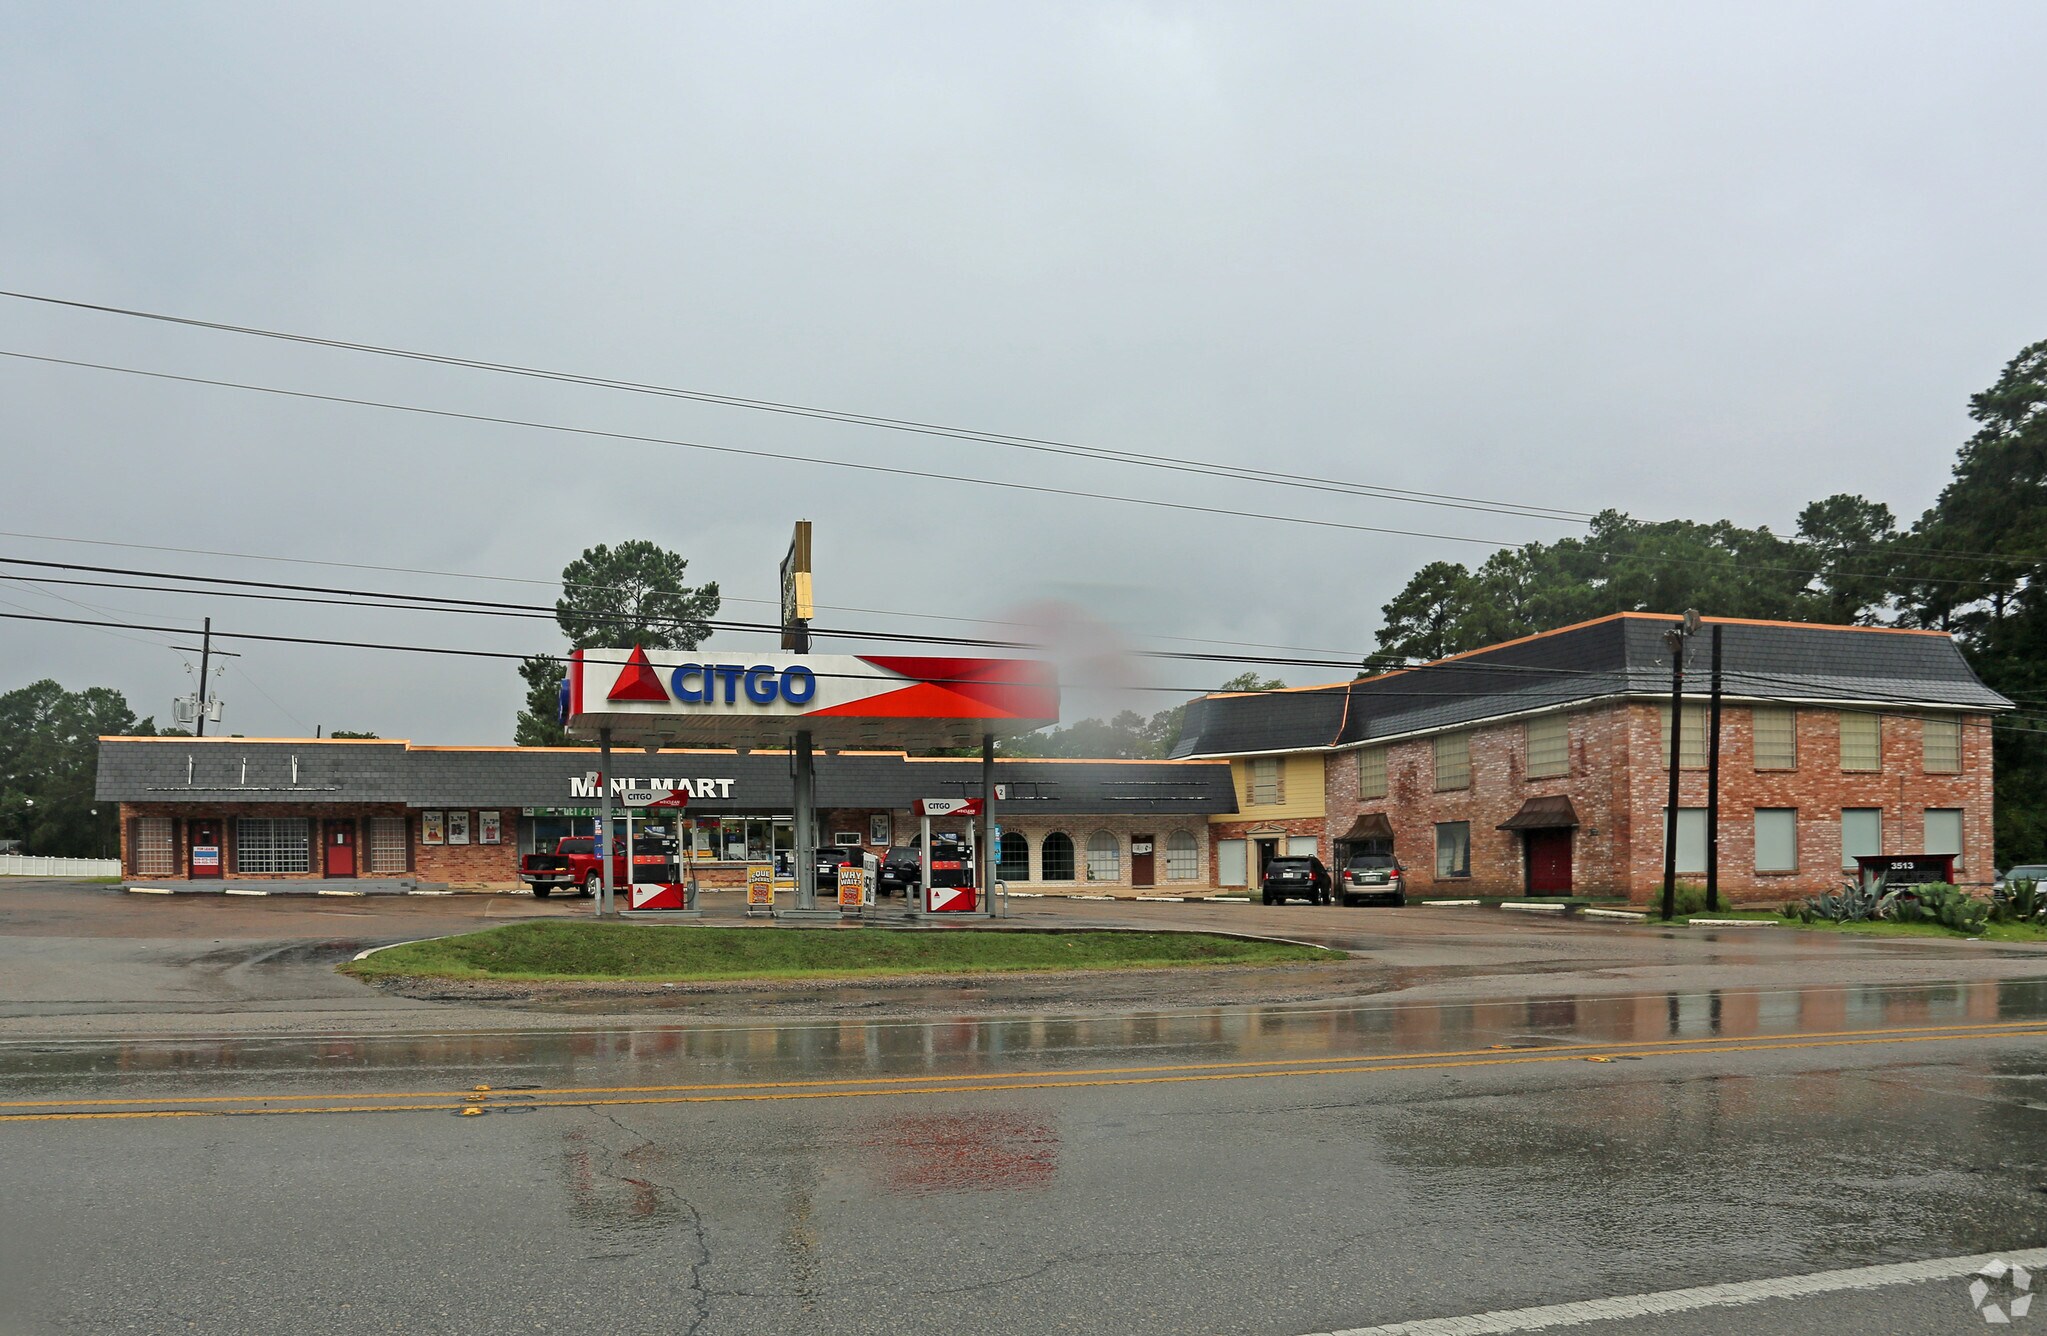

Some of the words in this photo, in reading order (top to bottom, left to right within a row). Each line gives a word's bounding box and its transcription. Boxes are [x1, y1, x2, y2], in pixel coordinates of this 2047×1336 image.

[671, 662, 816, 704] CITGO
[650, 778, 735, 798] MART
[1891, 862, 1914, 870] 3513
[841, 871, 862, 879] WHY
